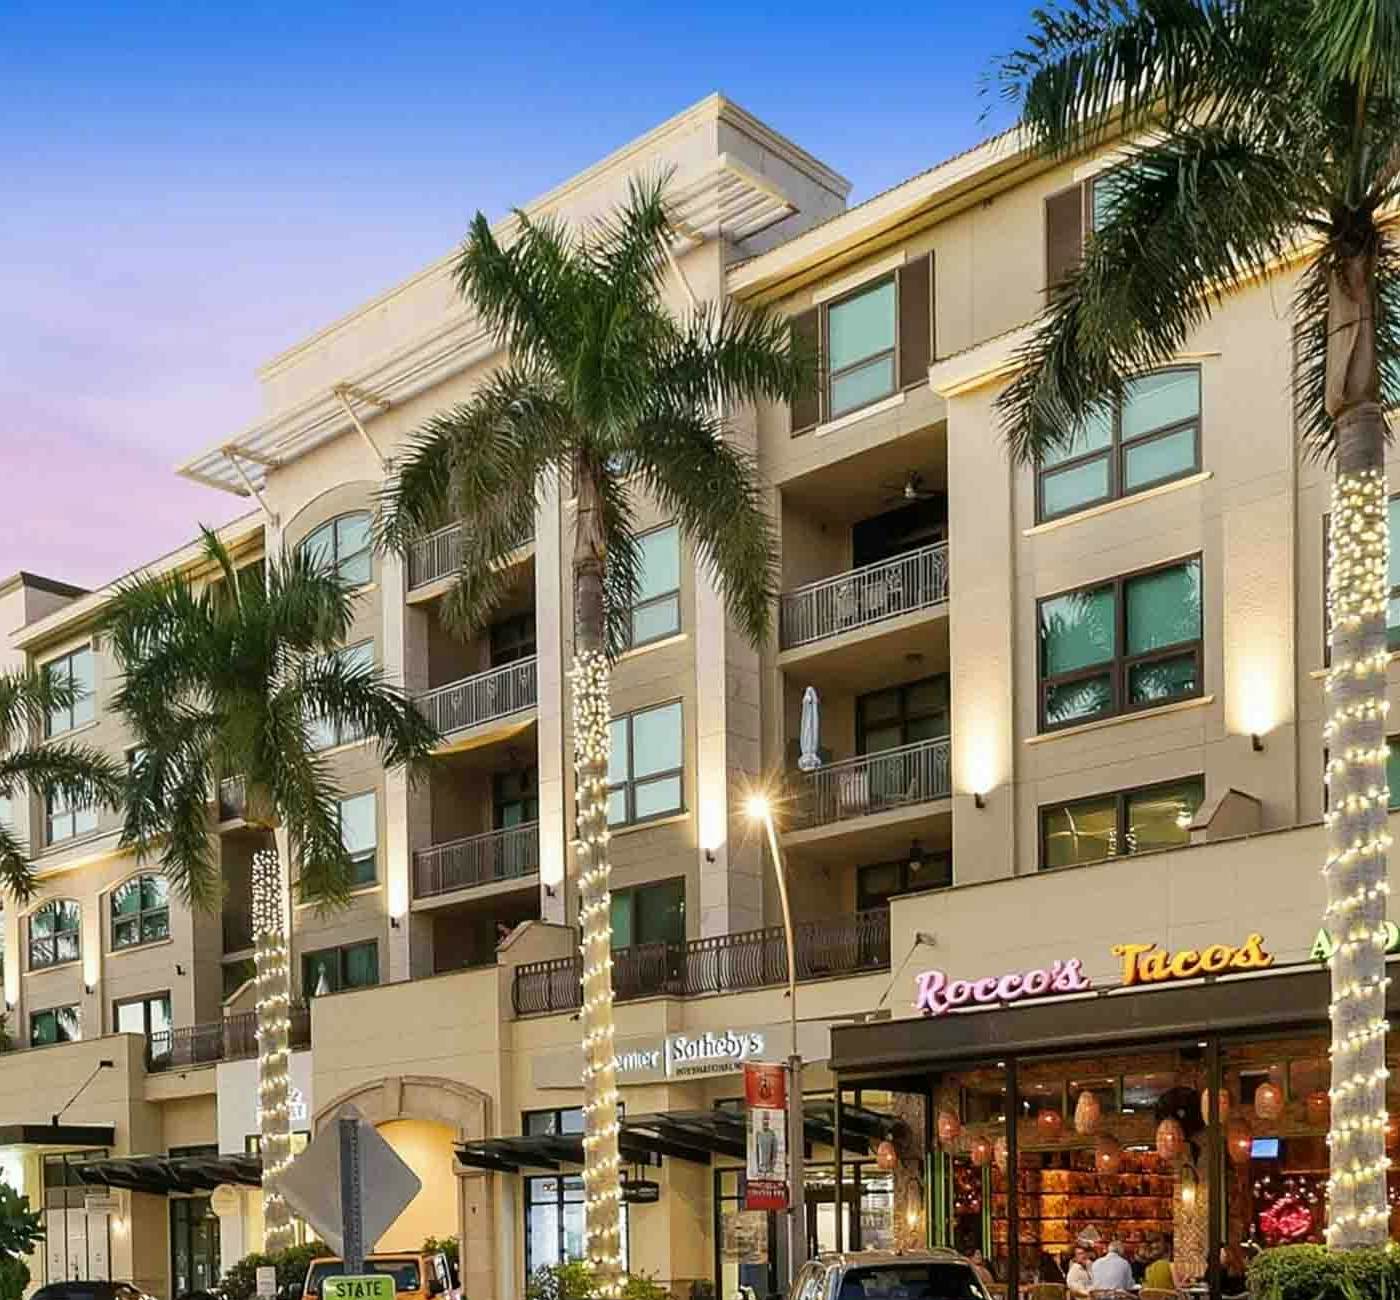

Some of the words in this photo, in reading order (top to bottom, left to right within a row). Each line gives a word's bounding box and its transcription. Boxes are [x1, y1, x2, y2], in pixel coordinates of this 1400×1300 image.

[914, 960, 1093, 1016] Rocco's
[1110, 933, 1272, 984] Tacos
[1309, 920, 1400, 960] AD
[673, 1030, 764, 1060] Sotheby's
[336, 1281, 382, 1297] STATE
